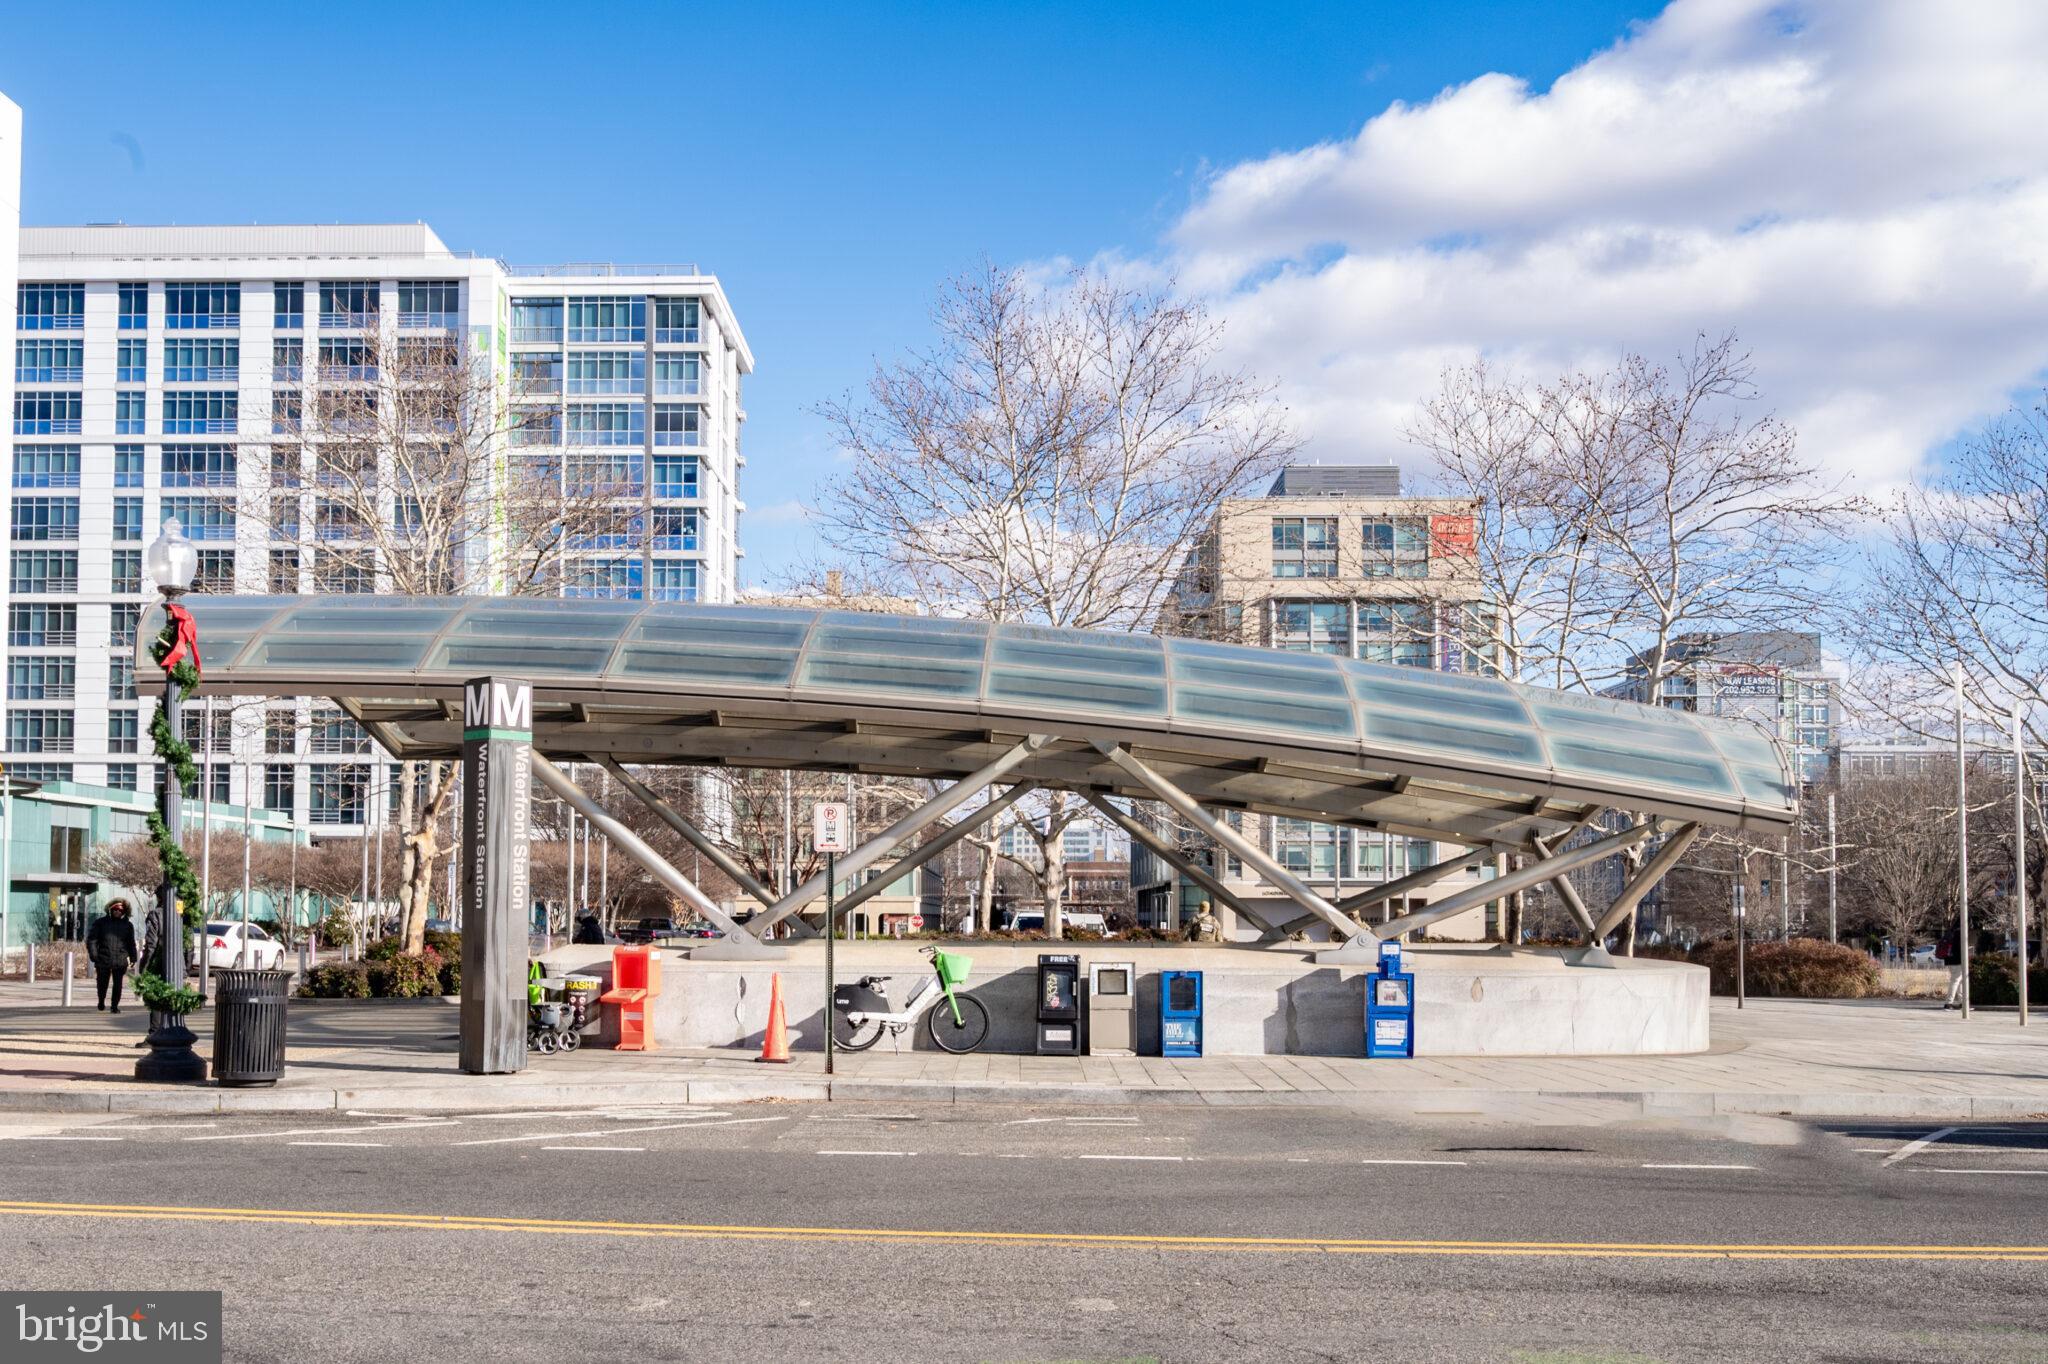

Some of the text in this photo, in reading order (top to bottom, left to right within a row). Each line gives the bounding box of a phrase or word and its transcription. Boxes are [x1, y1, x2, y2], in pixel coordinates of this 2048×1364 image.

[1724, 676, 1776, 685] NOW LEASING
[465, 683, 490, 727] M
[493, 682, 530, 728] M
[475, 743, 488, 909] Waterfront Station
[512, 745, 529, 909] Waterfront Station
